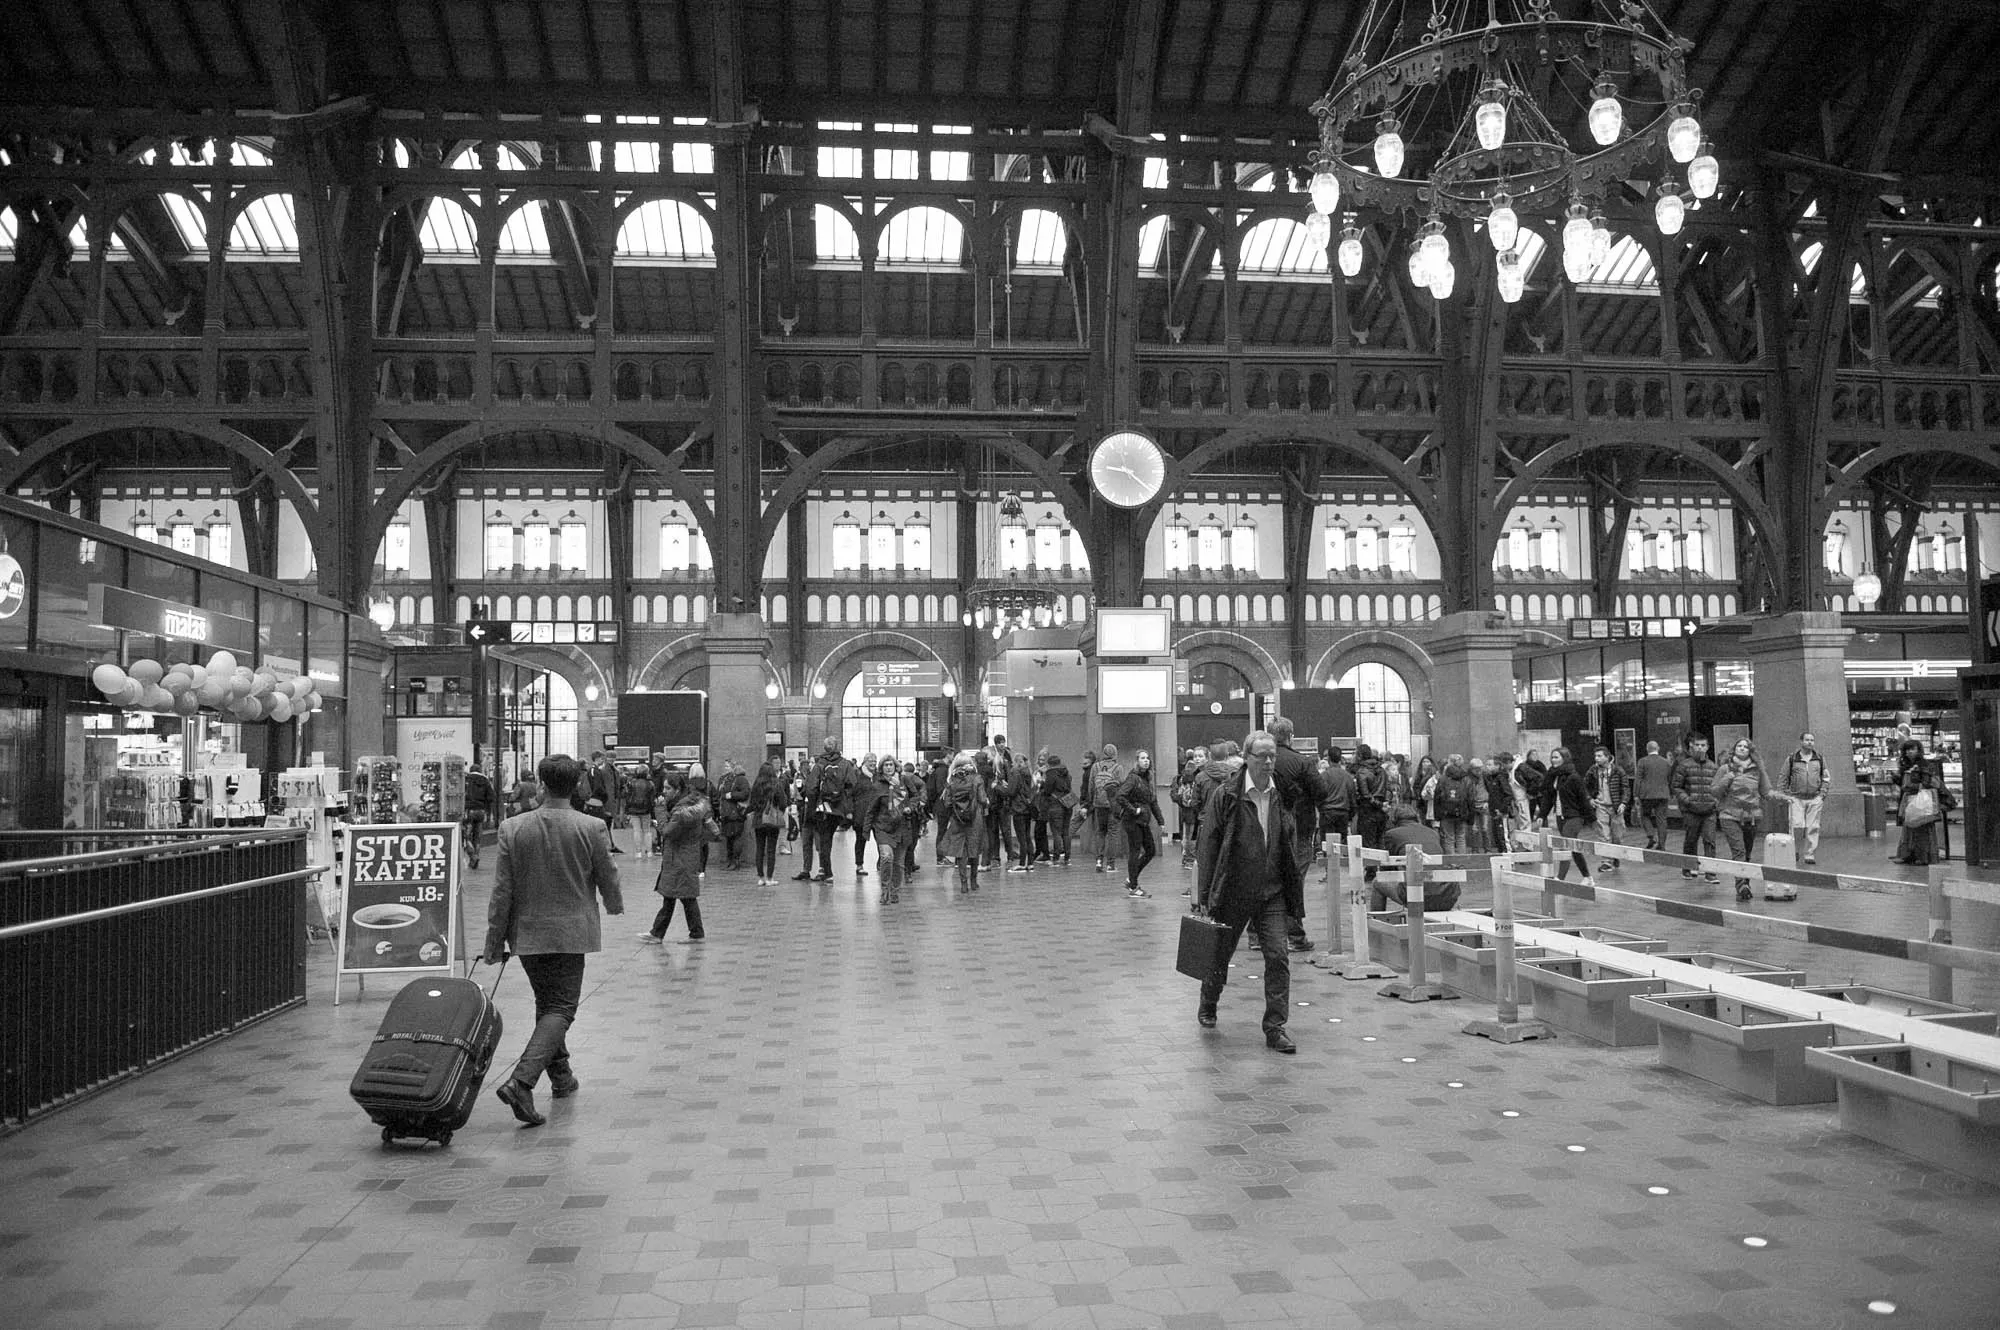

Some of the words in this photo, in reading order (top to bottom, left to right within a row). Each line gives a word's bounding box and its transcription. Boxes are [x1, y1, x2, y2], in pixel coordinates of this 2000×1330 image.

[165, 608, 206, 640] matas
[355, 834, 446, 862] STOR
[354, 860, 446, 882] KAFFE
[422, 1033, 445, 1041] ROYAL
